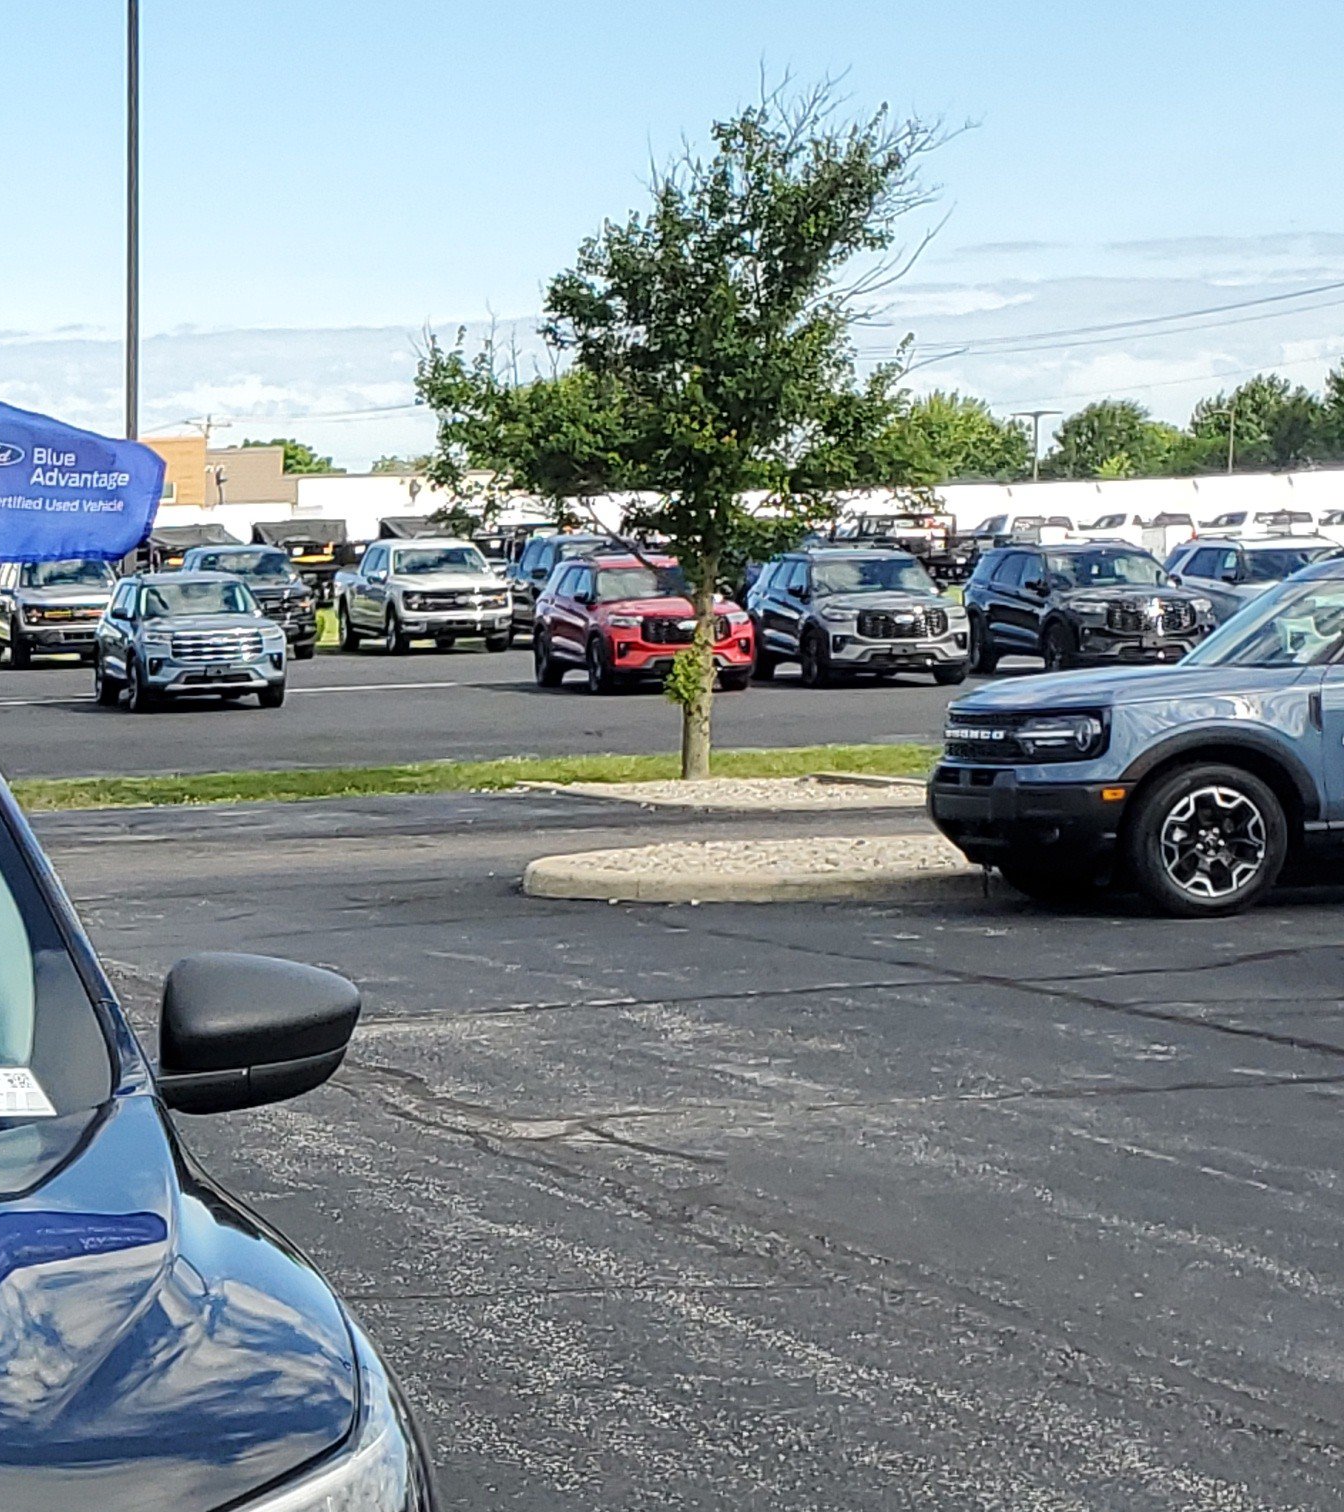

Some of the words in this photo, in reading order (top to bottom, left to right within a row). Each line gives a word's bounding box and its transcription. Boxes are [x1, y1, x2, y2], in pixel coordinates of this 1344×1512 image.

[33, 447, 76, 467] Blue
[30, 468, 130, 490] Advantage
[45, 498, 79, 512] Used
[83, 499, 124, 512] Vehicle
